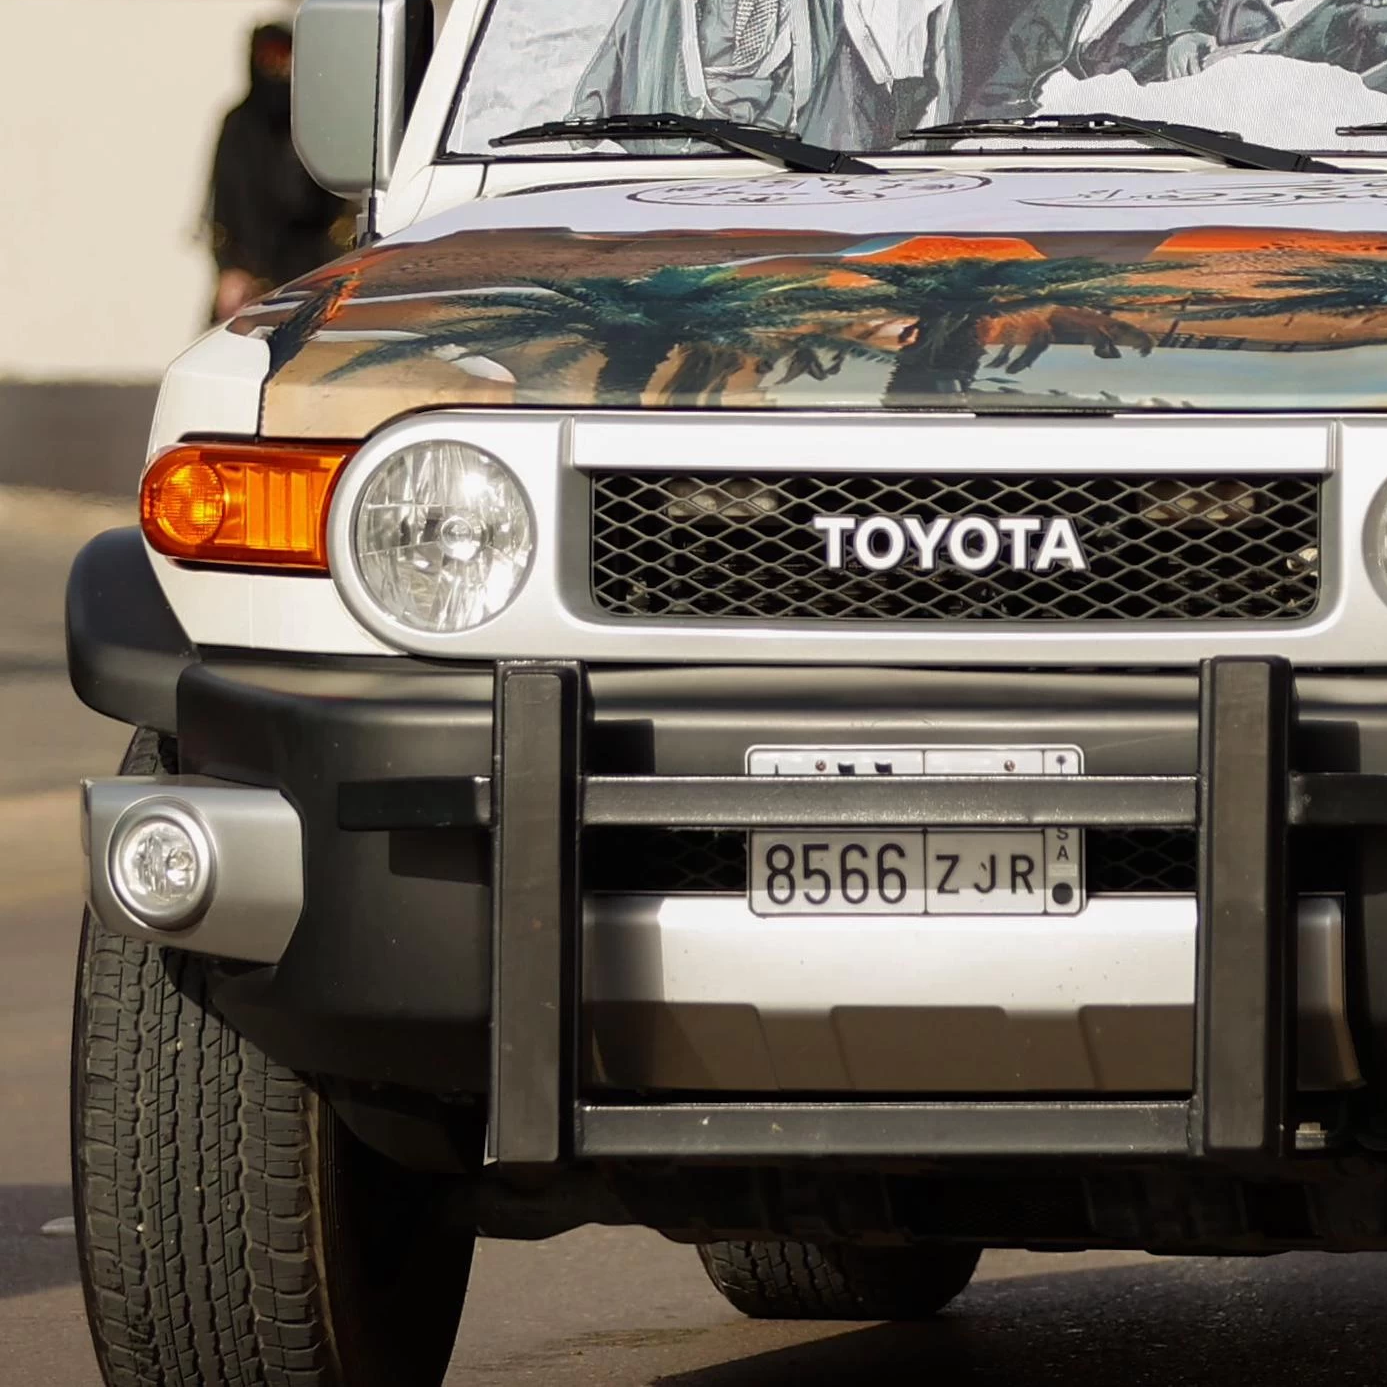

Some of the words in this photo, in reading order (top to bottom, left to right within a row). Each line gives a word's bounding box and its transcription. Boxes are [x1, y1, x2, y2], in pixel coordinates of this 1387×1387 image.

[812, 515, 1090, 571] TOYOTA
[1055, 826, 1070, 862] SA
[765, 842, 908, 905] 8566
[935, 853, 1036, 895] ZJR
